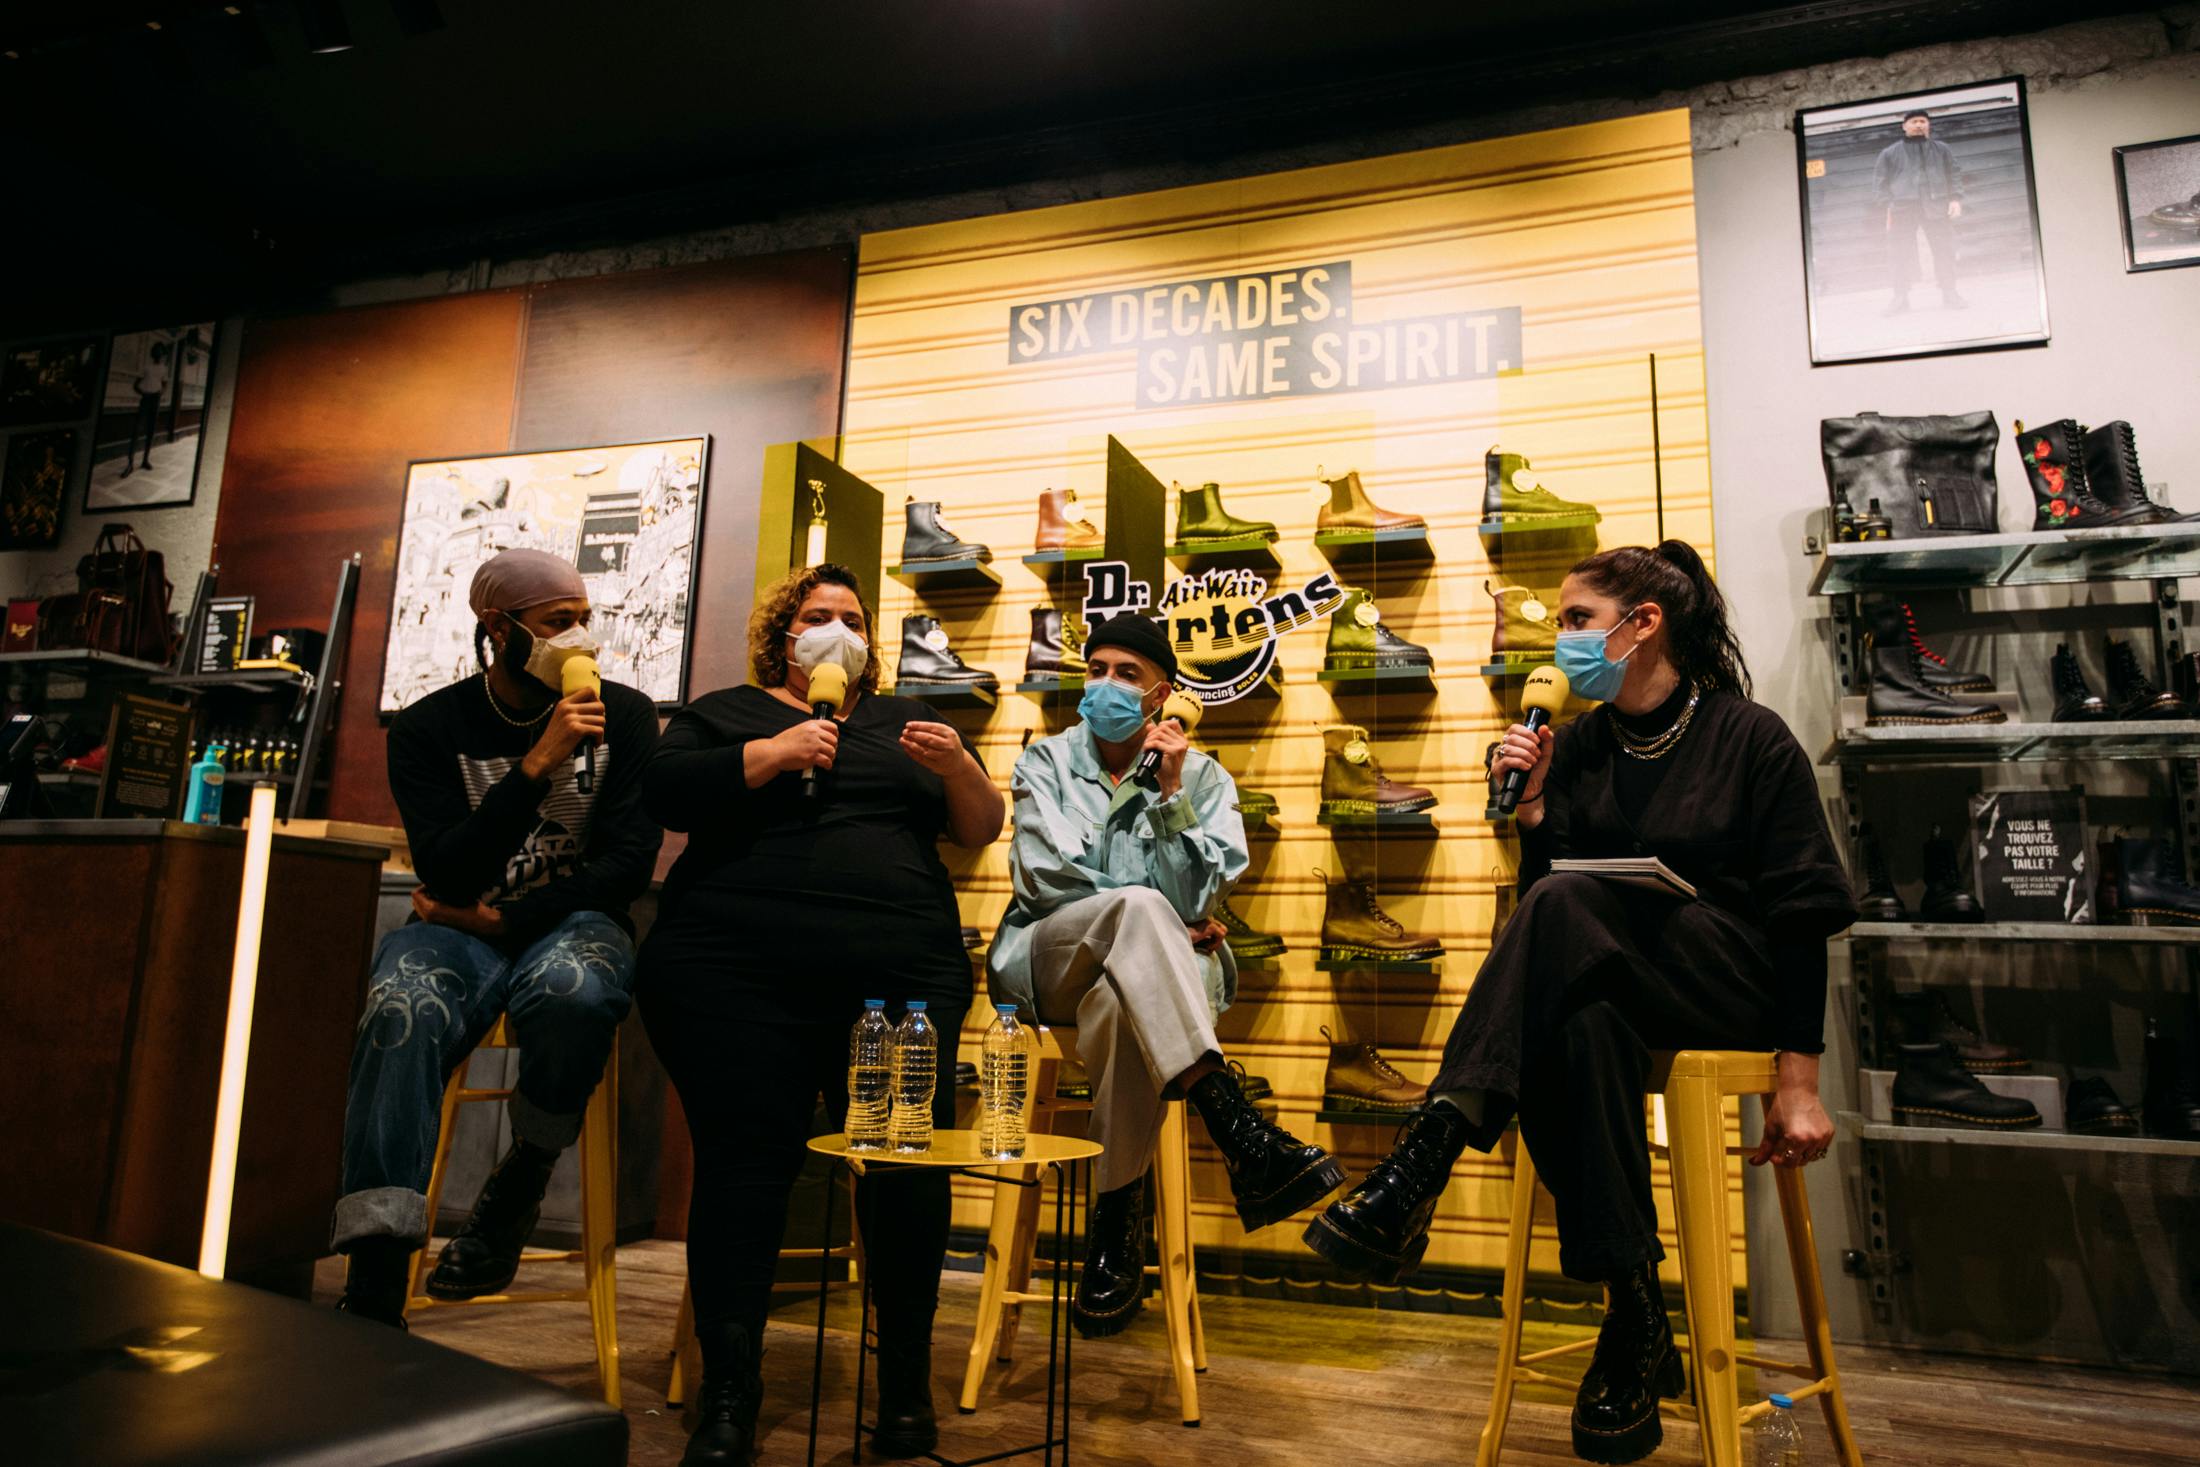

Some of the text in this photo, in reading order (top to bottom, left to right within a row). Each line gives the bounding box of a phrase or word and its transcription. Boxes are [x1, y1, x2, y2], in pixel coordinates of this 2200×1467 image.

[1017, 268, 1346, 358] SIX DECADES.
[1146, 315, 1510, 404] SAME SPIRIT.
[1086, 565, 1147, 609] Dr.
[1161, 571, 1265, 609] AirWair
[2007, 820, 2051, 832] VOUS NE
[2007, 833, 2053, 844] TROUVEZ
[2004, 845, 2059, 857] PAS VOTRE
[2011, 858, 2054, 870] TAILLE ?
